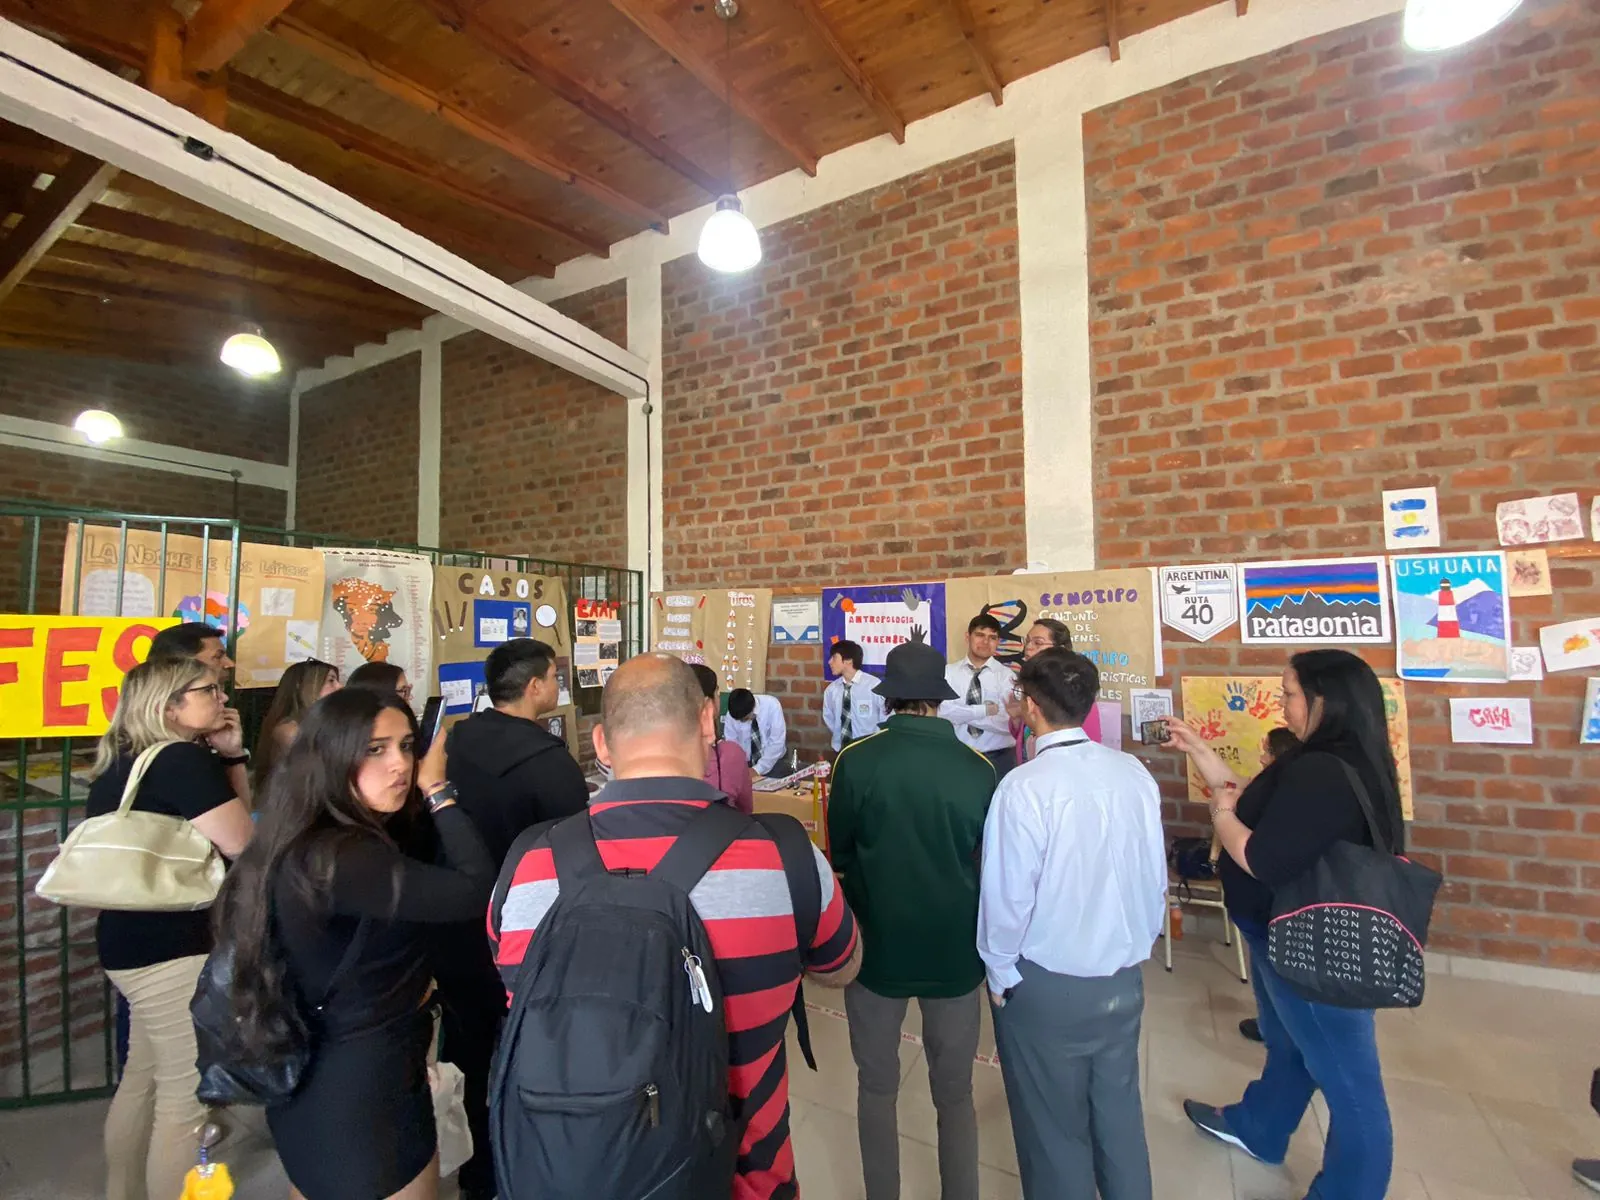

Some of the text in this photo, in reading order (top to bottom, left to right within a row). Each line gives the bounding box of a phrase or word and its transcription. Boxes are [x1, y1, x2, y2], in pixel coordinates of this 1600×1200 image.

[85, 535, 117, 565] LA
[224, 556, 252, 573] LS
[1396, 558, 1499, 577] USHUAIA
[1166, 570, 1229, 581] ARGENTINA
[458, 573, 543, 599] CASOS
[1040, 588, 1138, 607] GENOTIPO
[1184, 596, 1209, 605] RUTA
[849, 616, 914, 624] ANTROPOLOGIA
[1181, 604, 1214, 624] 40
[1075, 623, 1091, 632] DE
[1081, 650, 1130, 667] OTIPO
[1323, 906, 1359, 918] AVON
[1286, 920, 1313, 930] AVON
[1323, 916, 1359, 928] AVON
[1285, 930, 1313, 941] AVON
[1324, 926, 1360, 939] AVON
[1285, 939, 1314, 952] AVON
[1324, 937, 1360, 950] AVON
[1284, 949, 1315, 962] AVON
[1324, 948, 1360, 961] AVON
[1325, 959, 1361, 972] AVON
[1326, 970, 1362, 982] AVON
